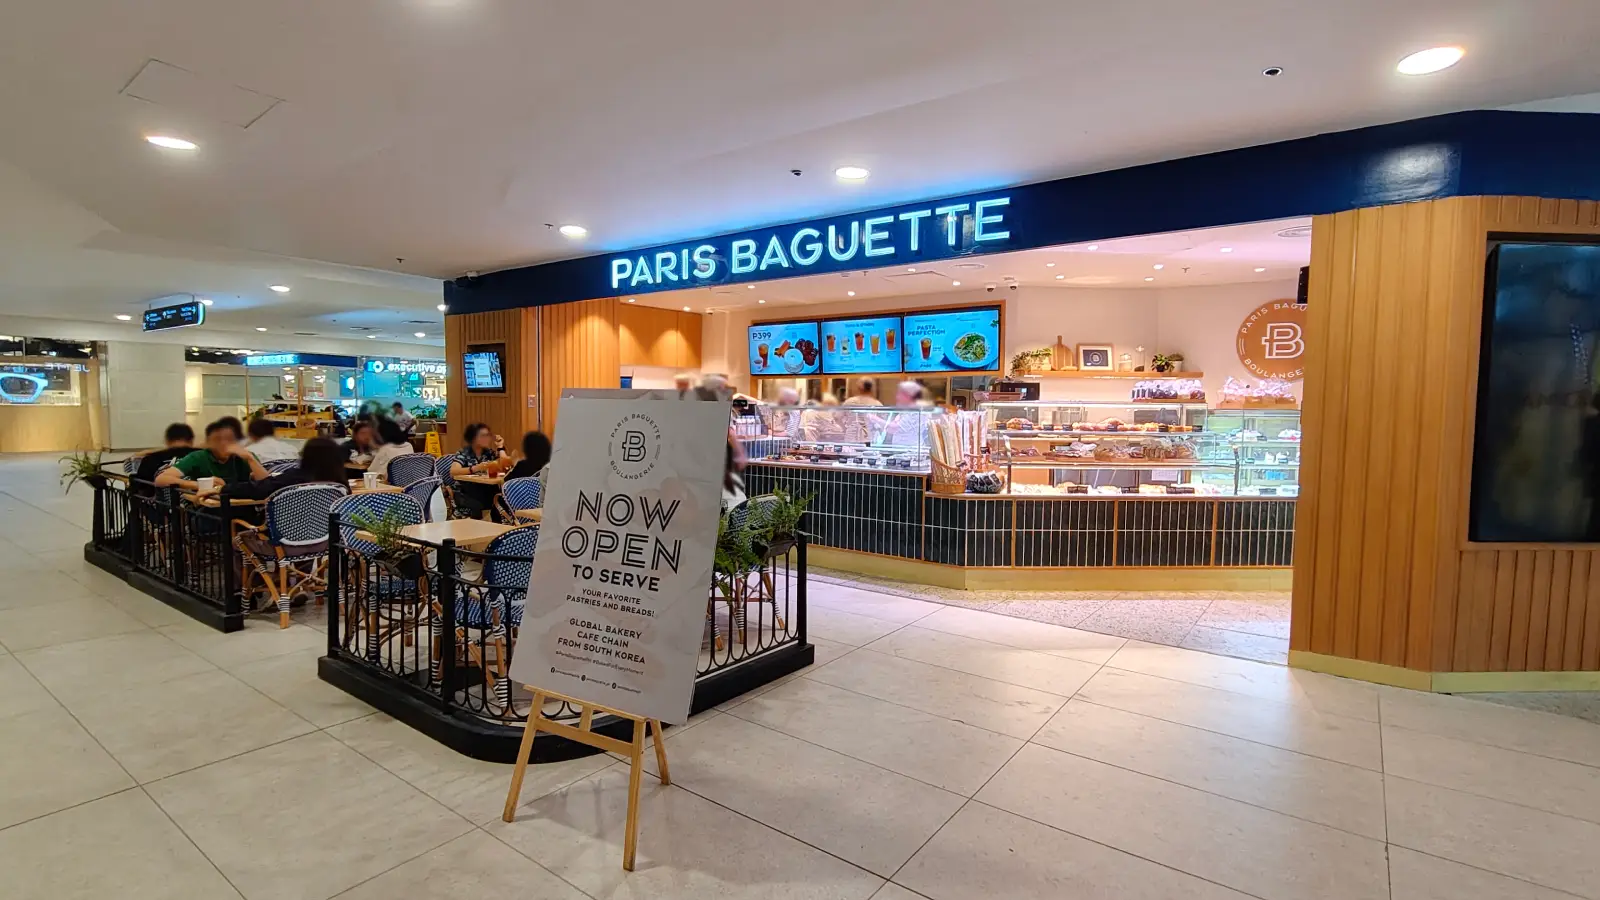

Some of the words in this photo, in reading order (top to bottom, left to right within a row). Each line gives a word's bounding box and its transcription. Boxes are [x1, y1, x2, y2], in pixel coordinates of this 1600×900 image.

[611, 245, 717, 289] PARIS
[731, 197, 1012, 274] BAGUETTE
[1241, 307, 1268, 334] PARIS
[1274, 303, 1308, 312] BAGU
[908, 329, 946, 337] PERFECTION
[1244, 358, 1305, 379] BOULANGE
[610, 416, 629, 438] PARIS
[631, 413, 661, 440] BAGUETTE
[610, 460, 655, 480] BOULANGERIE
[575, 489, 681, 532] NOW
[562, 526, 682, 575] OPEN
[572, 564, 594, 580] TO
[599, 568, 660, 592] SERVE
[566, 594, 601, 607] PASTRIES
[602, 602, 619, 611] AND
[620, 604, 655, 617] BREADS!
[582, 588, 602, 598] YOUR
[603, 592, 641, 605] FAVORITE
[569, 617, 603, 632] GLOBAL
[605, 625, 643, 640] BAKERY
[577, 631, 600, 642] CAFE
[601, 636, 629, 648] CHAIN
[557, 637, 582, 649] FROM
[583, 643, 613, 656] SOUTH
[614, 650, 646, 664] KOREA
